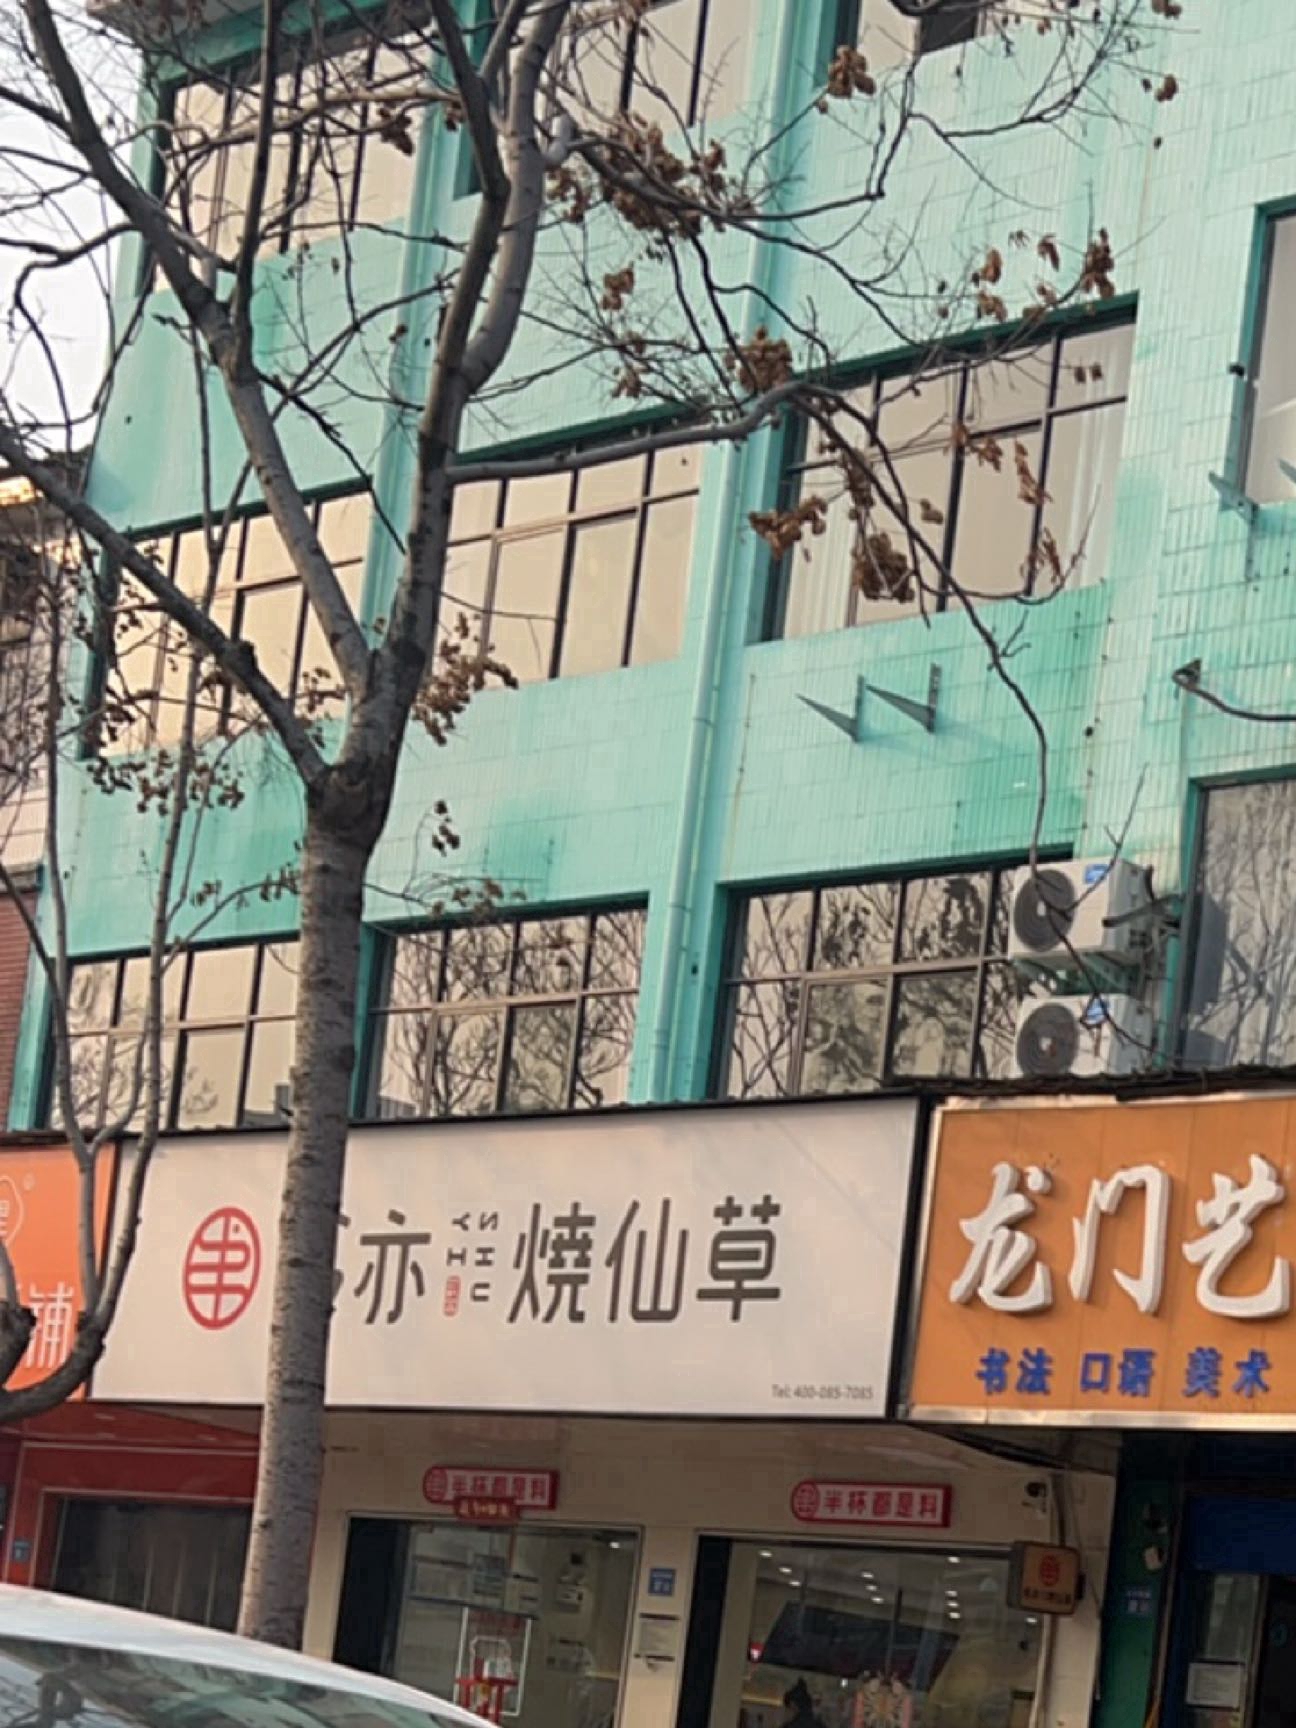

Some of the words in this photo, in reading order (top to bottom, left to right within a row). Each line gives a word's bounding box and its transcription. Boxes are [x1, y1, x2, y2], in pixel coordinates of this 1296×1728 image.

[332, 1208, 432, 1325] 亦
[508, 1195, 783, 1325] 燒仙草
[976, 1347, 1054, 1396] 书法
[1079, 1348, 1157, 1396] 口语
[1183, 1347, 1272, 1398] 美术
